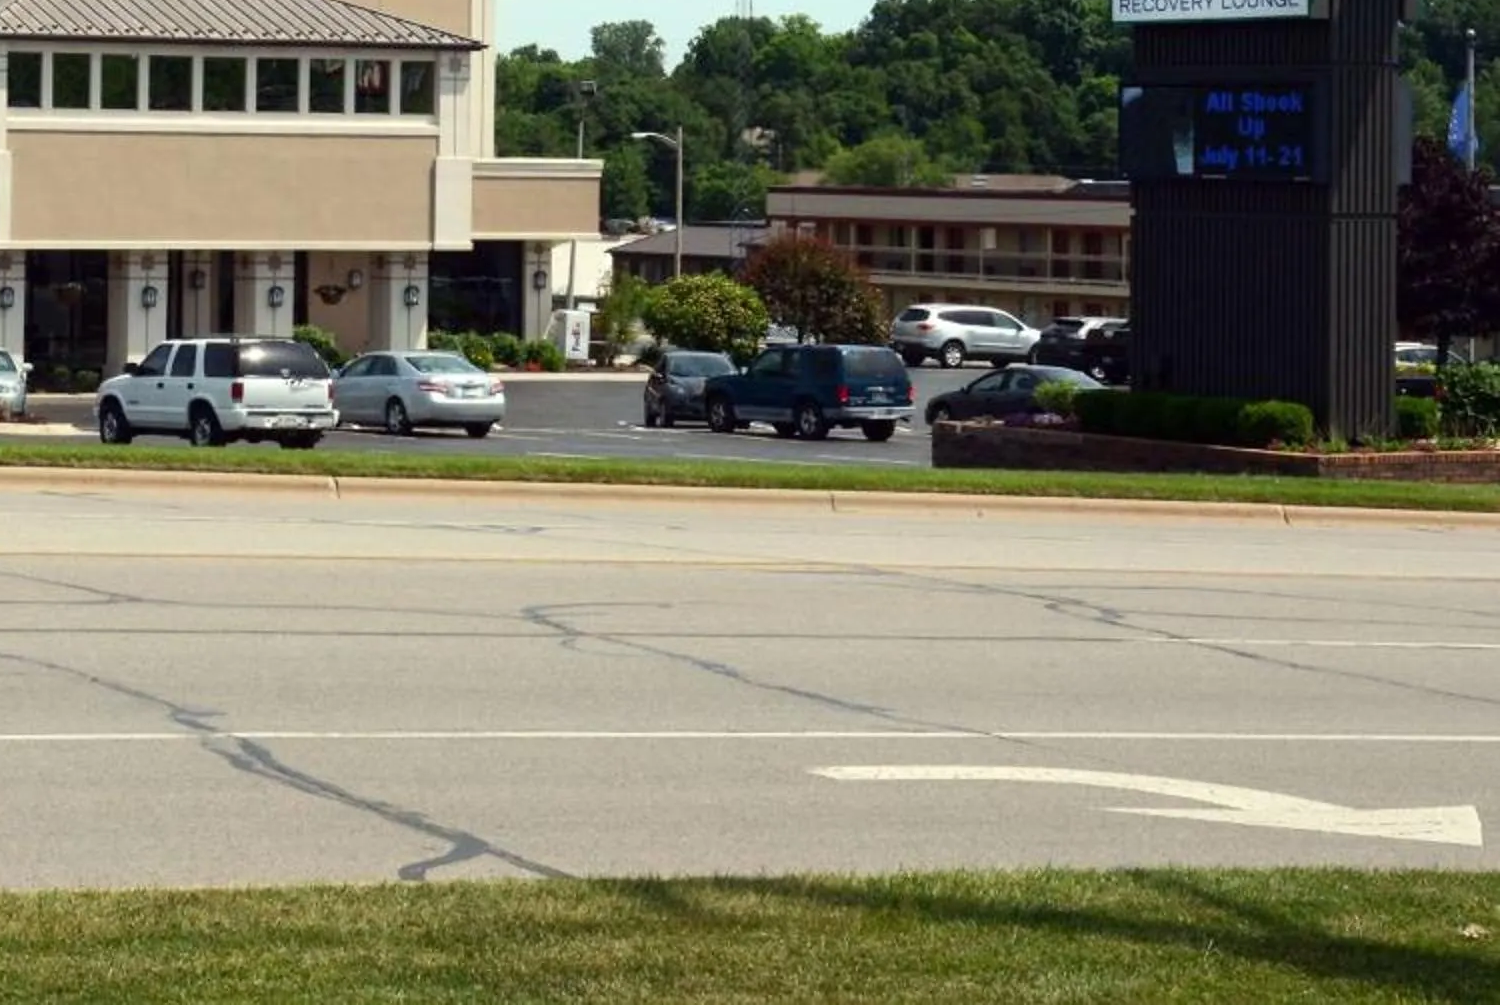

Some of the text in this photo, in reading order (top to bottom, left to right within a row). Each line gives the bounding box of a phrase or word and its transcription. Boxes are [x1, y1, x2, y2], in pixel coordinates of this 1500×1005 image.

[1206, 90, 1233, 112] All
[1238, 115, 1265, 140] Up
[1199, 145, 1238, 171] July
